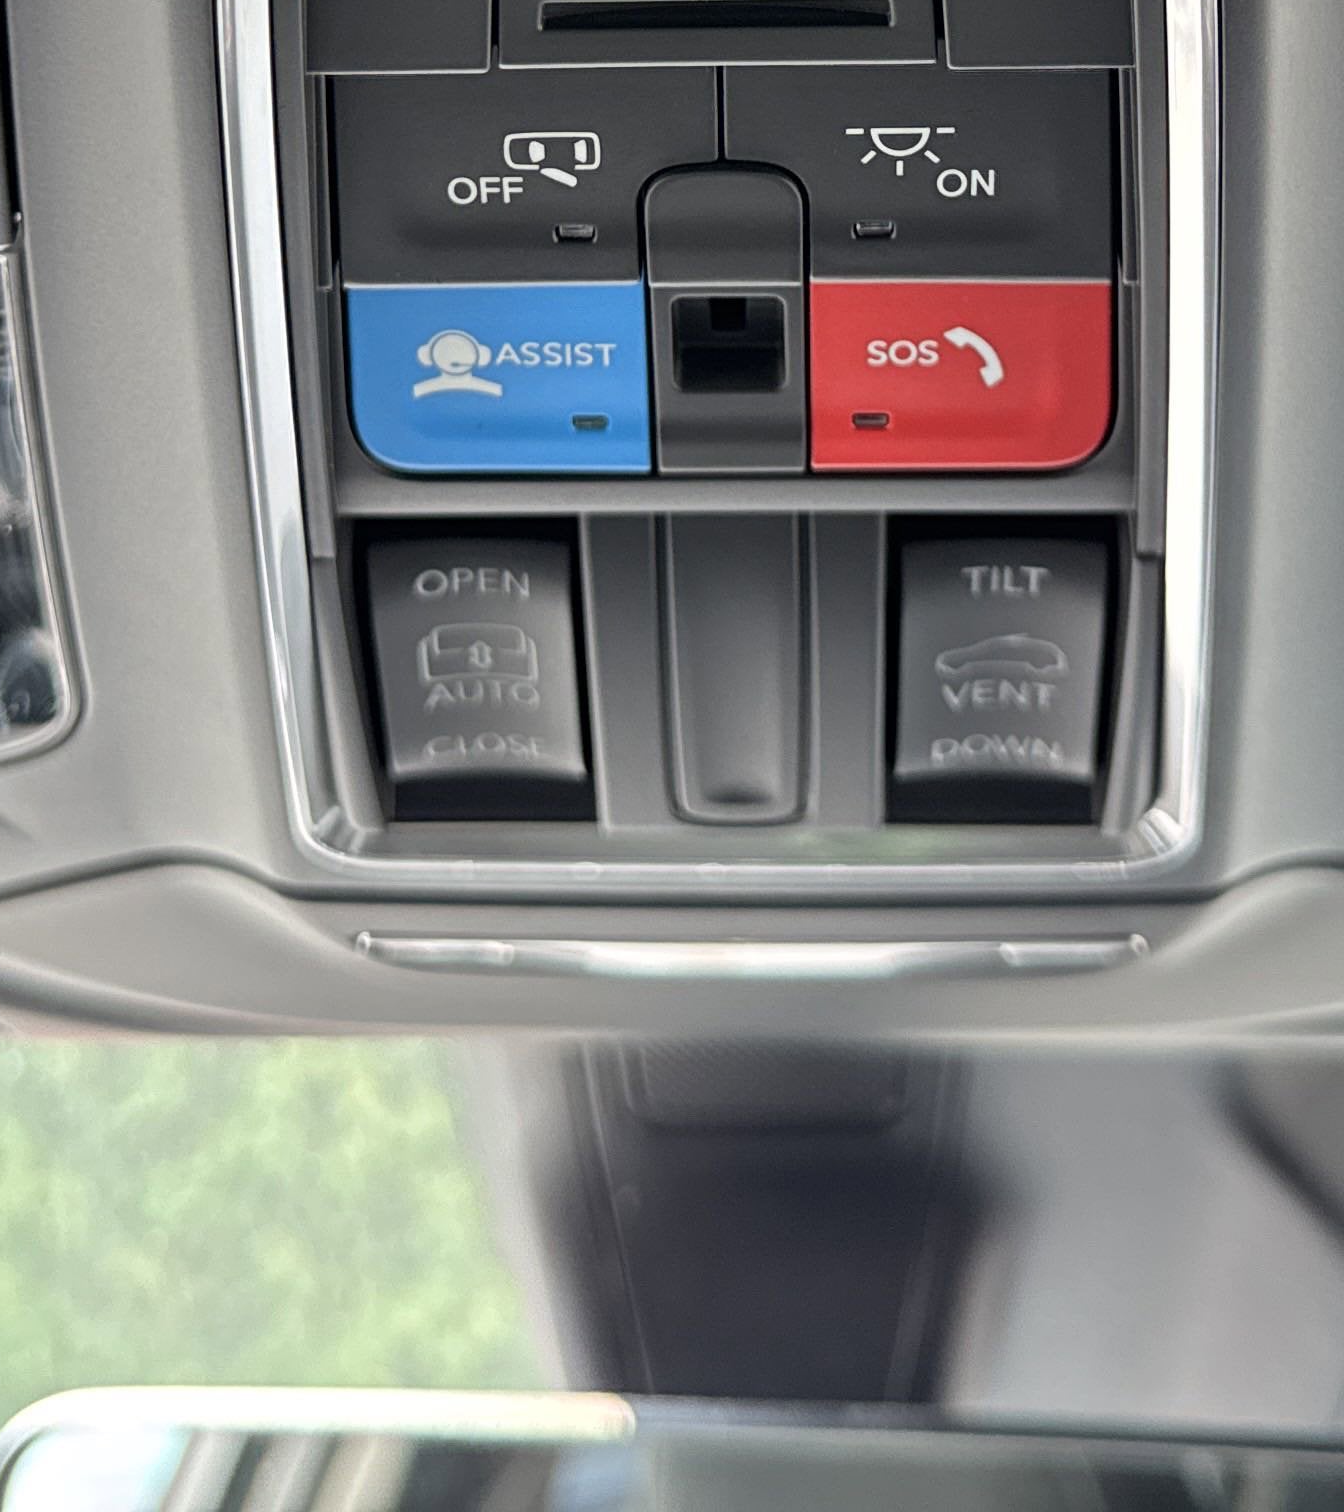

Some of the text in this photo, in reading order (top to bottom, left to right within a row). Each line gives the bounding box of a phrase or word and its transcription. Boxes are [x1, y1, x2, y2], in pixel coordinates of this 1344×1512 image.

[447, 176, 524, 205] OFF
[935, 169, 996, 198] ON
[495, 342, 617, 367] ASSIST
[867, 340, 939, 367] SOS
[413, 567, 530, 599] OPEN
[961, 565, 1049, 595] TILT
[424, 680, 540, 710] AUTO
[942, 679, 1057, 710] VENT
[930, 734, 1064, 766] DOWN
